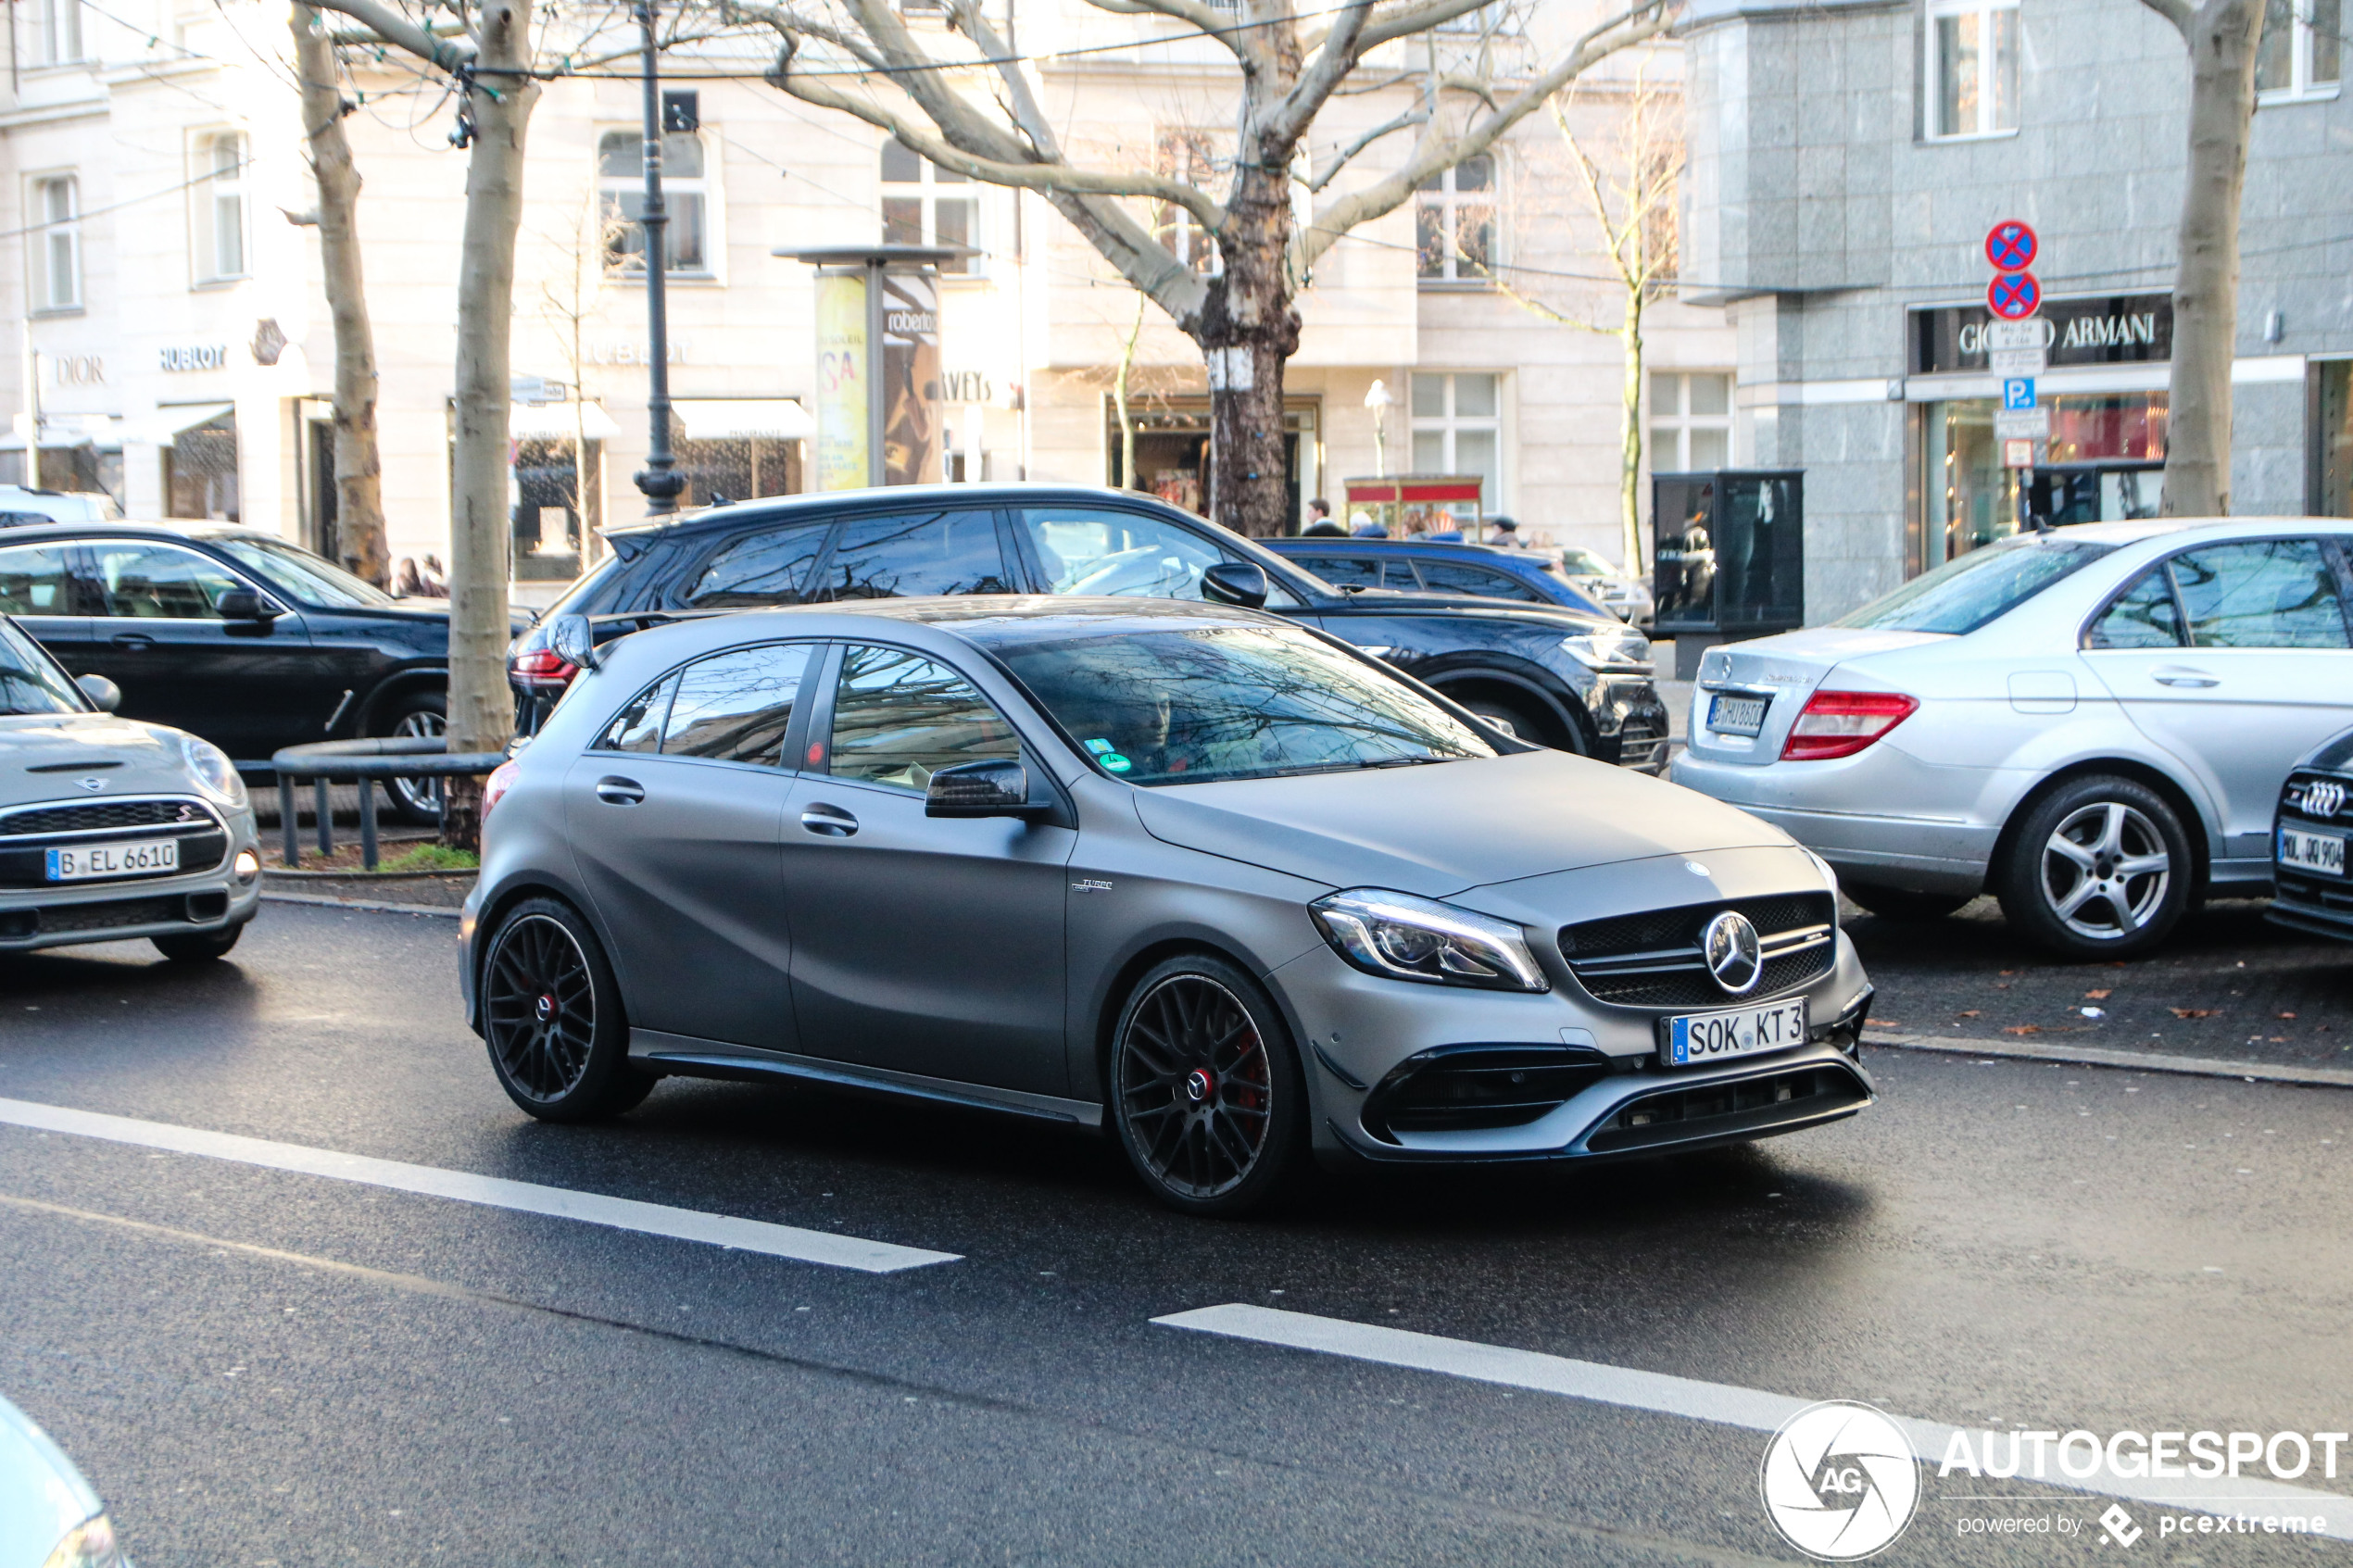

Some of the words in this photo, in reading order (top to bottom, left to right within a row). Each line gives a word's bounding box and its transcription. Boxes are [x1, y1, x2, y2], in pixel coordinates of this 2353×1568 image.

[887, 310, 931, 332] roberto
[2062, 312, 2156, 348] ARMANI
[57, 355, 105, 384] DIOR
[159, 344, 226, 370] HUBLOT
[2008, 380, 2027, 408] P
[1715, 700, 1723, 722] B
[62, 853, 75, 874] B
[91, 849, 118, 872] EL
[124, 844, 174, 870] 6610
[1083, 879, 1113, 888] TURBO
[1689, 1016, 1740, 1055] SOK
